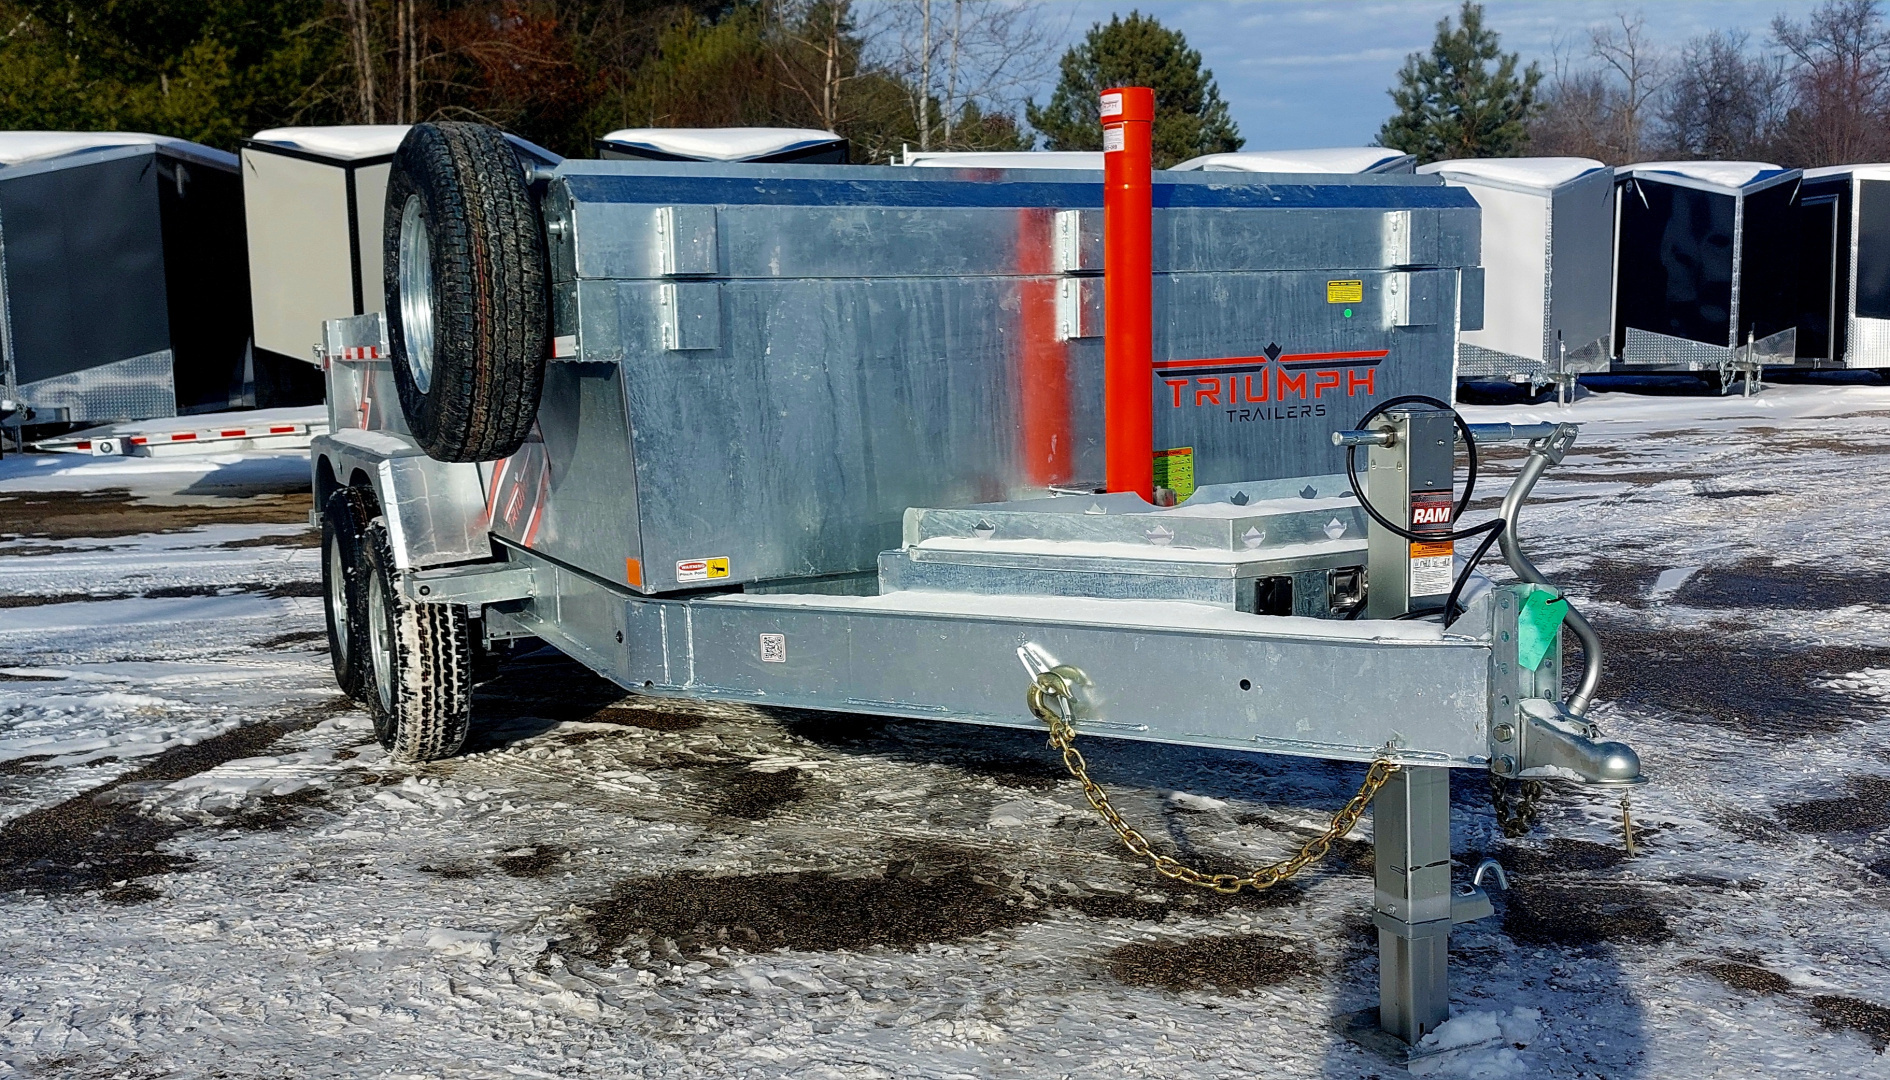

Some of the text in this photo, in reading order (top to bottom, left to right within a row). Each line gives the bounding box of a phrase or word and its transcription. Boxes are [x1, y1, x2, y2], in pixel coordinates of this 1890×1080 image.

[1164, 366, 1376, 408] TRIUMPH
[1226, 404, 1326, 423] TRAILERS
[1412, 507, 1451, 524] RAM
